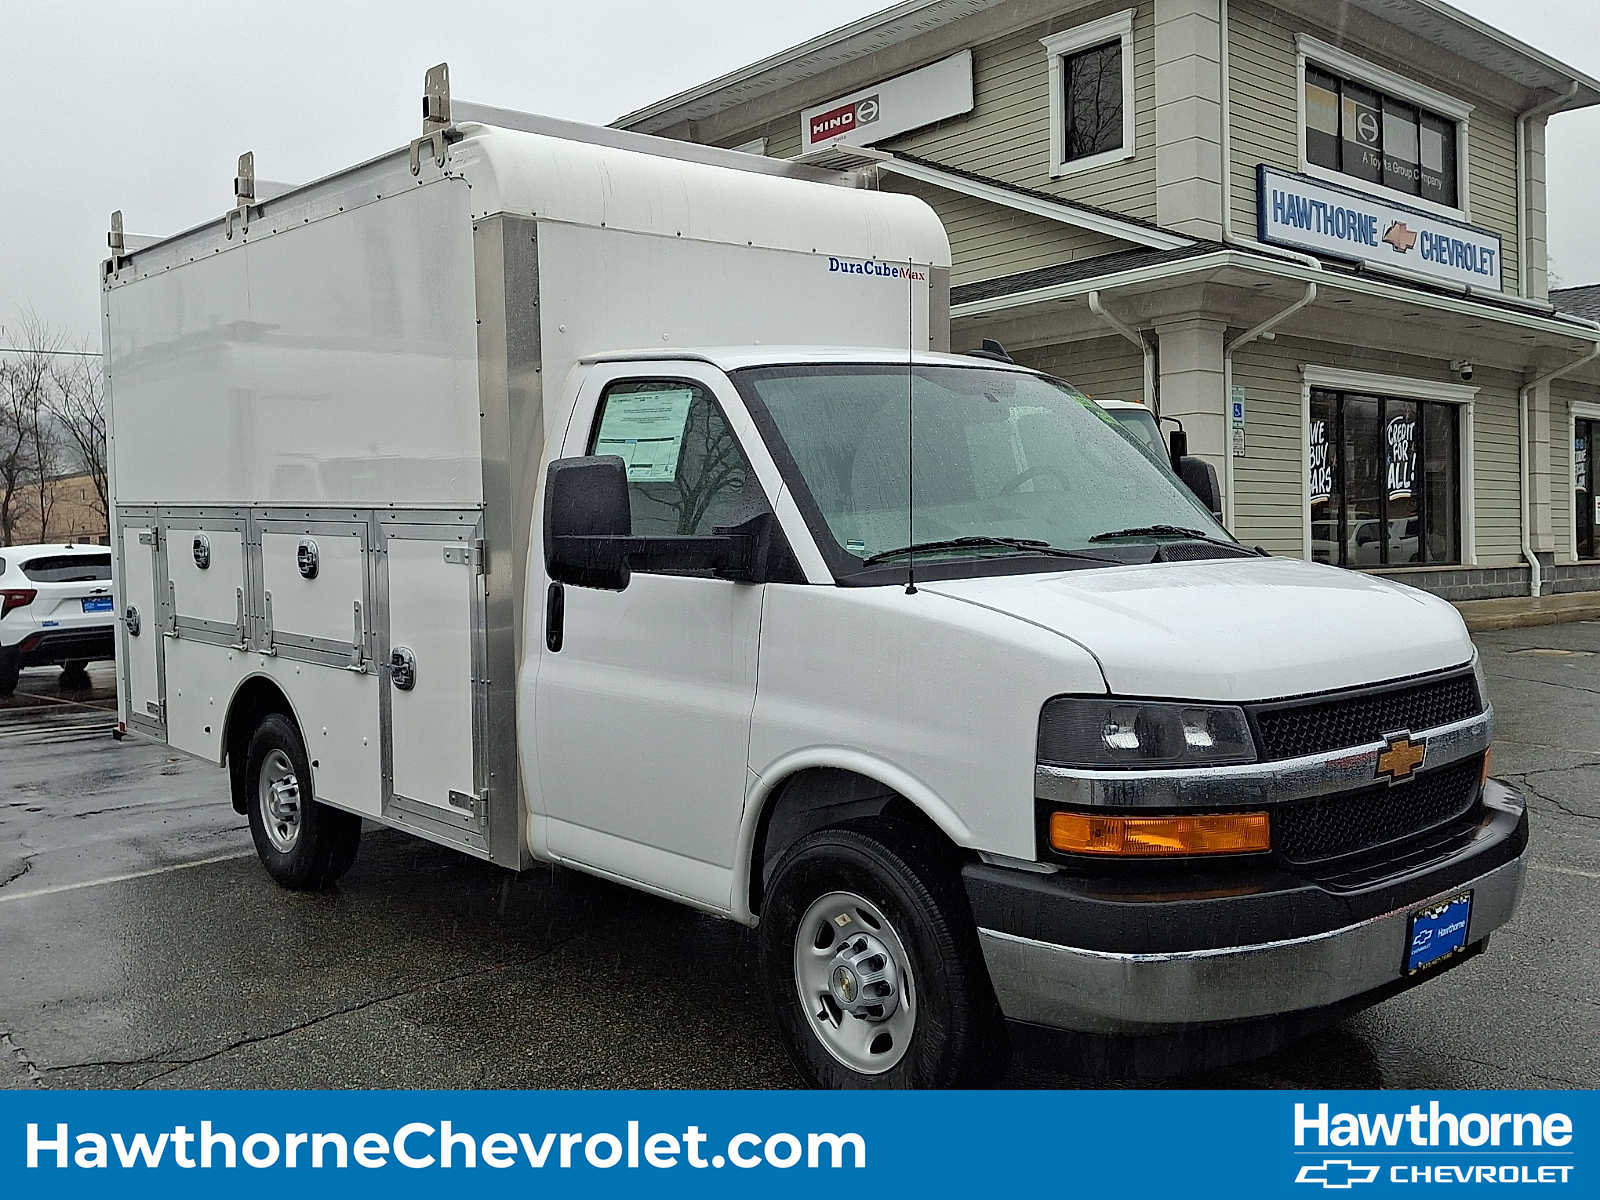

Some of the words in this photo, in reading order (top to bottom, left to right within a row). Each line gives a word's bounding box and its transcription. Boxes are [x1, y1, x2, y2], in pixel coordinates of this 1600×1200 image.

[812, 112, 853, 135] HINO
[1362, 151, 1369, 164] A
[1369, 153, 1392, 171] Toyta
[1392, 161, 1413, 181] Group
[1413, 168, 1443, 190] Cmpany
[1272, 189, 1379, 247] HAWTHORNE
[1420, 231, 1496, 276] CHEVROLET
[1309, 421, 1325, 445] WE
[1387, 422, 1416, 446] CREDIT
[1310, 442, 1329, 469] BUY
[1393, 440, 1409, 462] FOR
[1309, 466, 1332, 494] ARS
[1387, 452, 1417, 489] ALL!
[1438, 920, 1466, 938] Hawthorne
